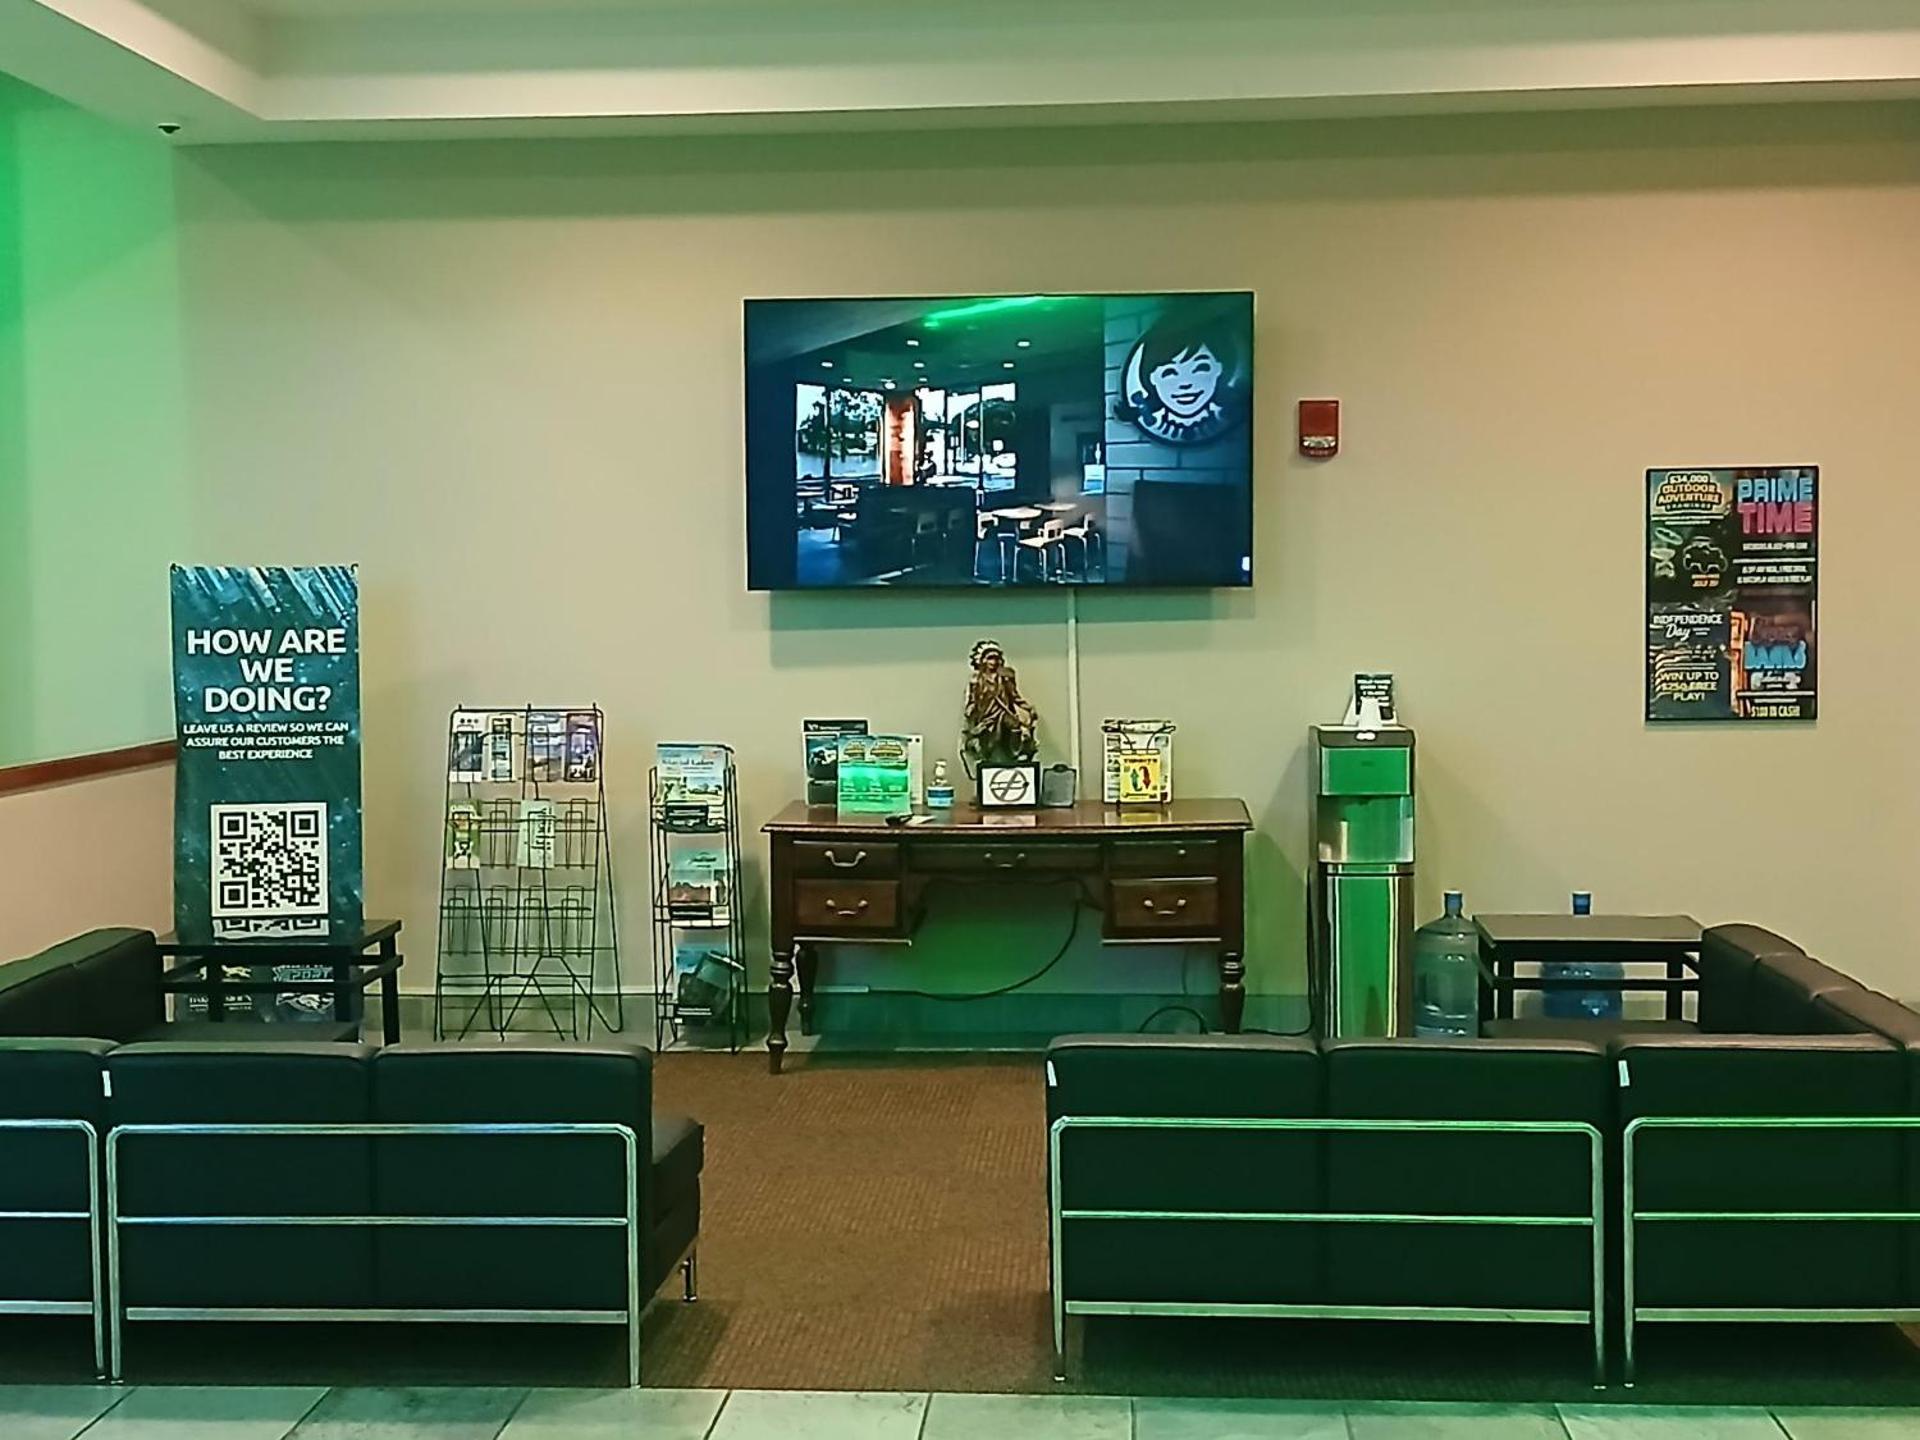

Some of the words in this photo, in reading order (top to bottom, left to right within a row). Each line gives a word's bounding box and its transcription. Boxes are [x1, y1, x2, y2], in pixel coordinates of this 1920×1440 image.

[1737, 477, 1814, 503] PRIME
[1737, 502, 1813, 534] TIME
[1653, 614, 1723, 625] INDEPENDENCE
[187, 630, 272, 655] HOW
[278, 628, 347, 654] ARE
[1665, 623, 1691, 642] Day
[240, 658, 295, 683] WE
[1686, 671, 1702, 681] UP
[1704, 671, 1720, 681] TO
[204, 686, 332, 713] DOING?
[183, 723, 219, 735] LEAVE
[219, 723, 234, 734] US
[235, 723, 245, 734] A
[246, 723, 289, 733] REVIEW
[289, 722, 305, 733] SO
[306, 722, 324, 732] WE
[325, 722, 349, 732] CAN
[186, 736, 230, 747] ASSURE
[230, 736, 254, 746] OUR
[255, 735, 321, 746] CUSTOMERS
[322, 735, 345, 745] THE
[218, 749, 245, 760] BEST
[247, 748, 313, 759] EXPERIENCE
